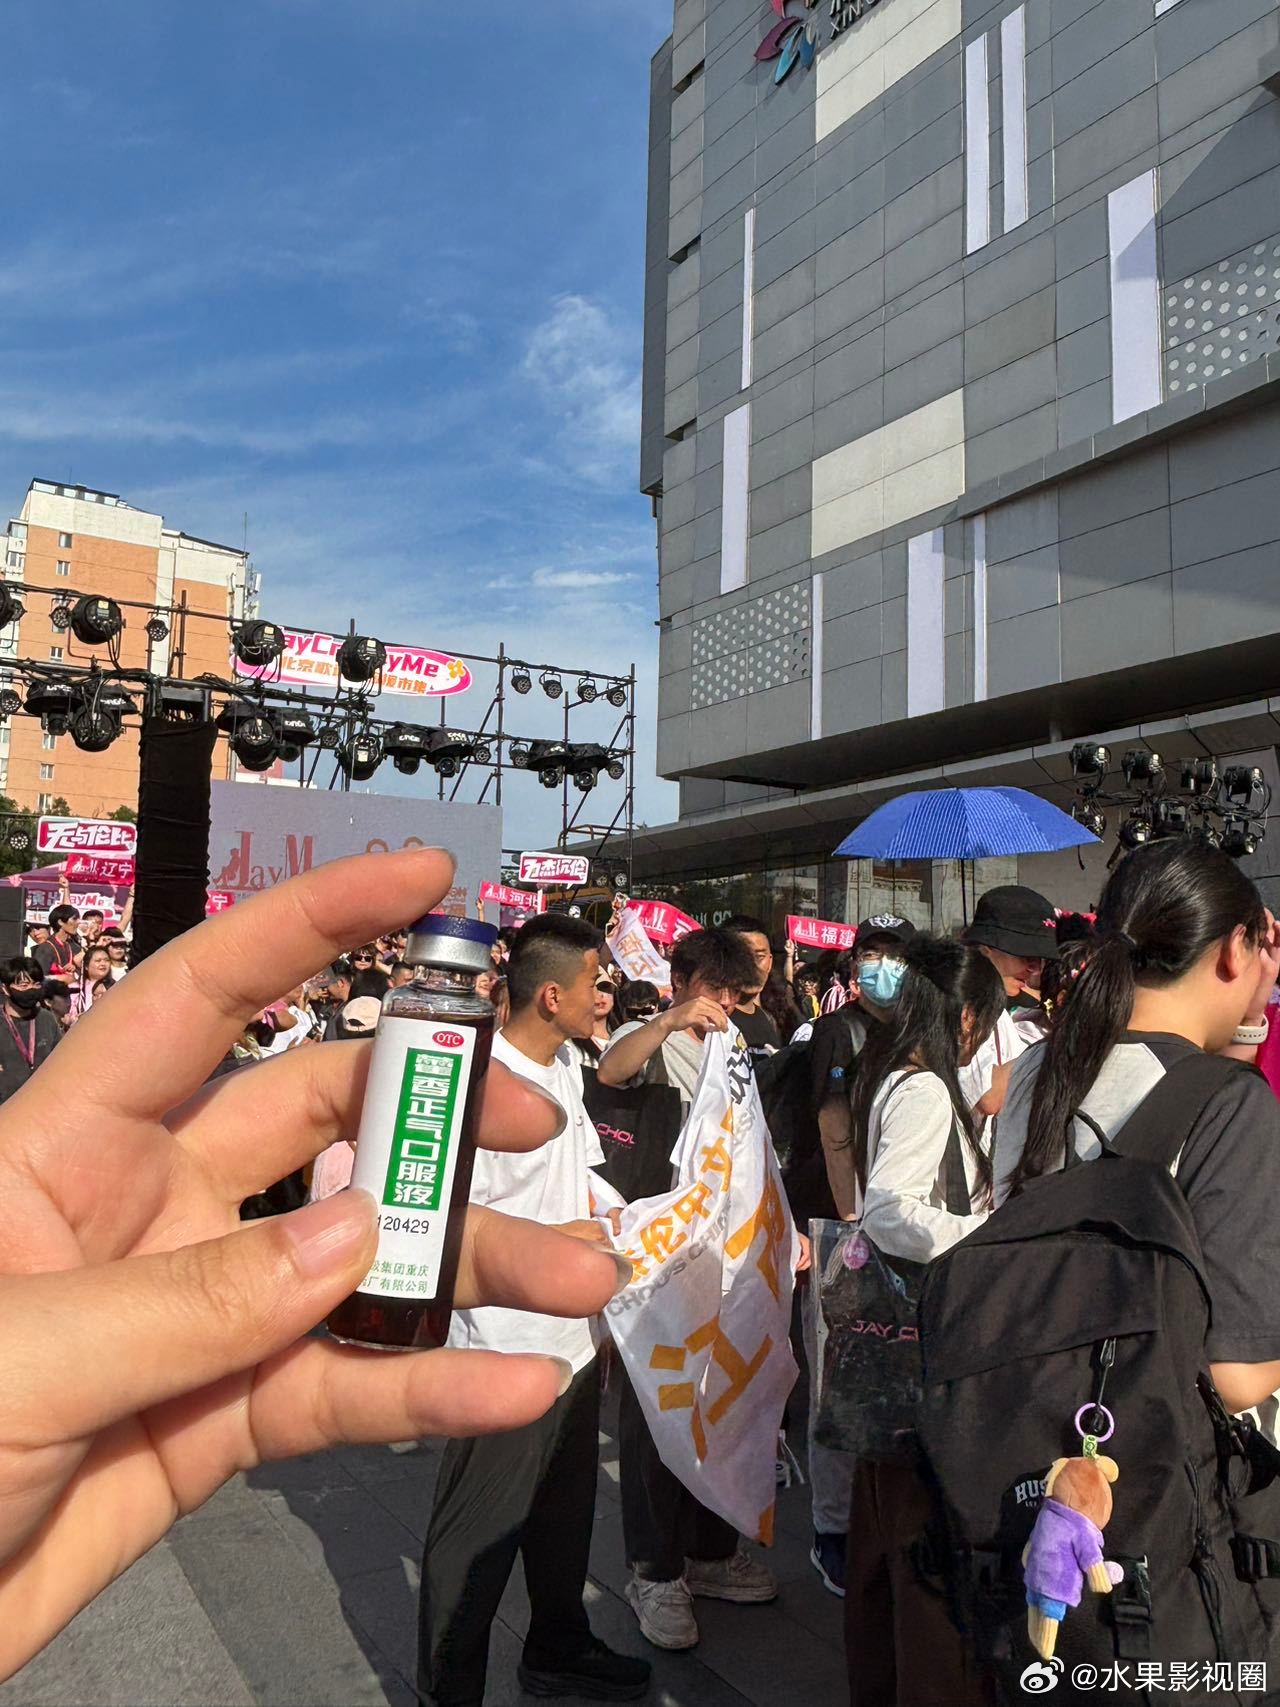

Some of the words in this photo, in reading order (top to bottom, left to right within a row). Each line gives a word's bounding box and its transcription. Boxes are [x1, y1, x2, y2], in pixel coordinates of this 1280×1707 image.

[45, 822, 133, 850] 无与伦比
[100, 861, 133, 879] 辽宁
[821, 925, 856, 948] 福建
[436, 1032, 461, 1045] OTC
[393, 1054, 454, 1206] 藿香正气口服液
[363, 1275, 428, 1294] 厂有限公司
[850, 1320, 894, 1337] JAY
